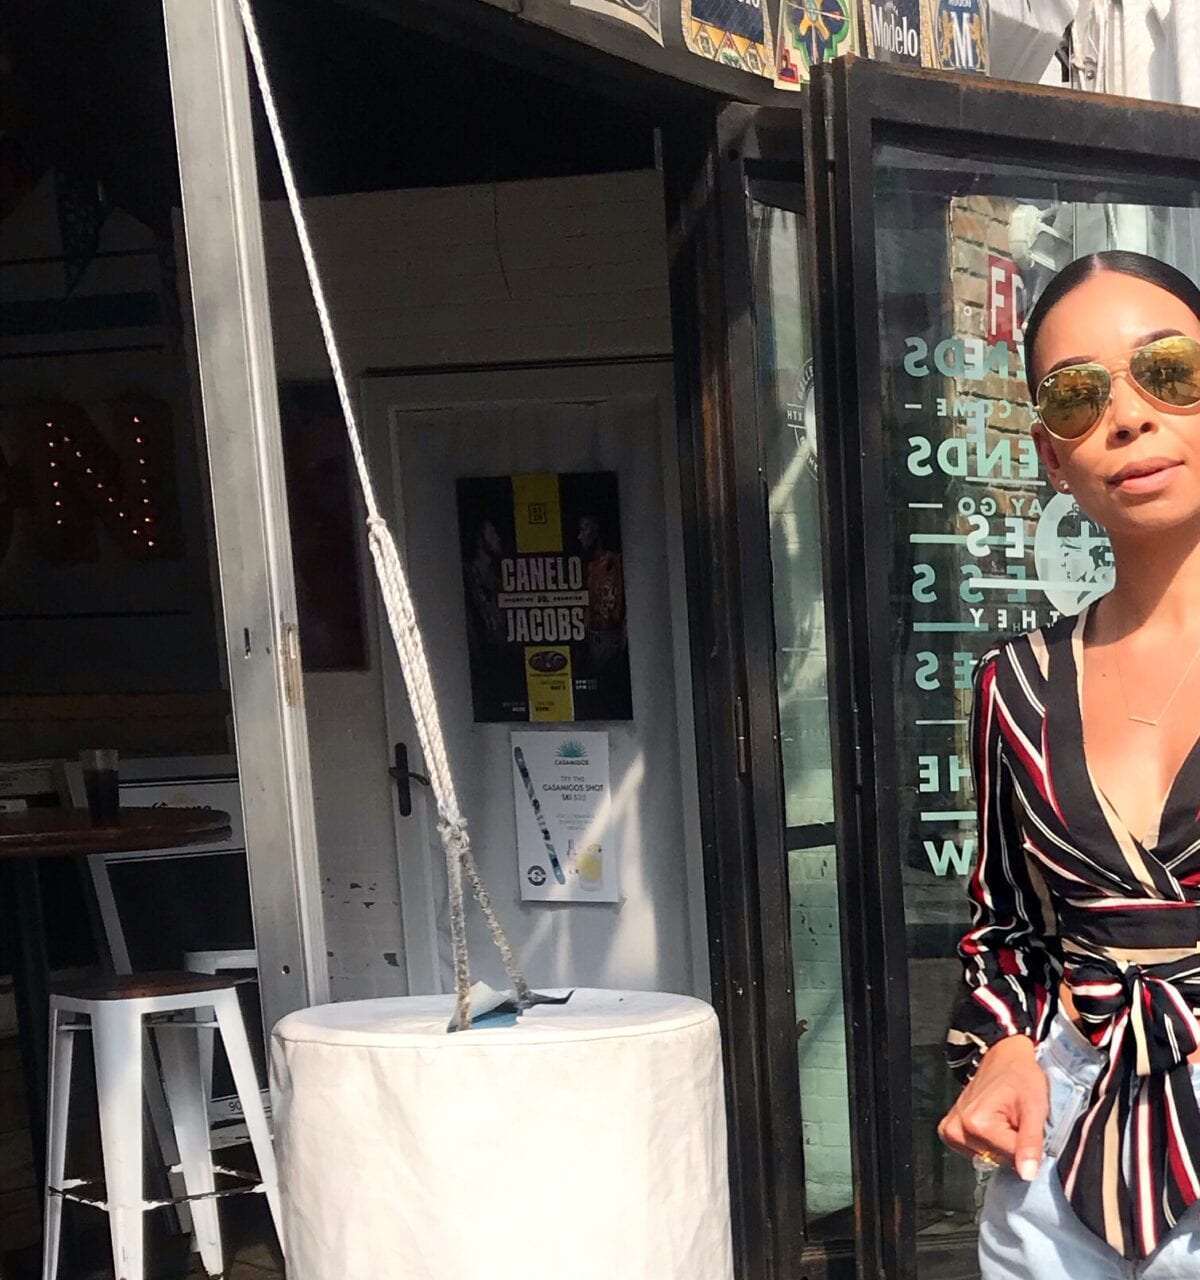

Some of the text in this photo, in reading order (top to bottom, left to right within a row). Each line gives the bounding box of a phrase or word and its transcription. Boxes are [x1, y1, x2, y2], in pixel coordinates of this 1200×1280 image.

[871, 4, 918, 57] Modelo
[501, 556, 583, 592] CANELO
[506, 607, 586, 643] JACOBS
[542, 783, 604, 792] CASAMIGOS SHOT
